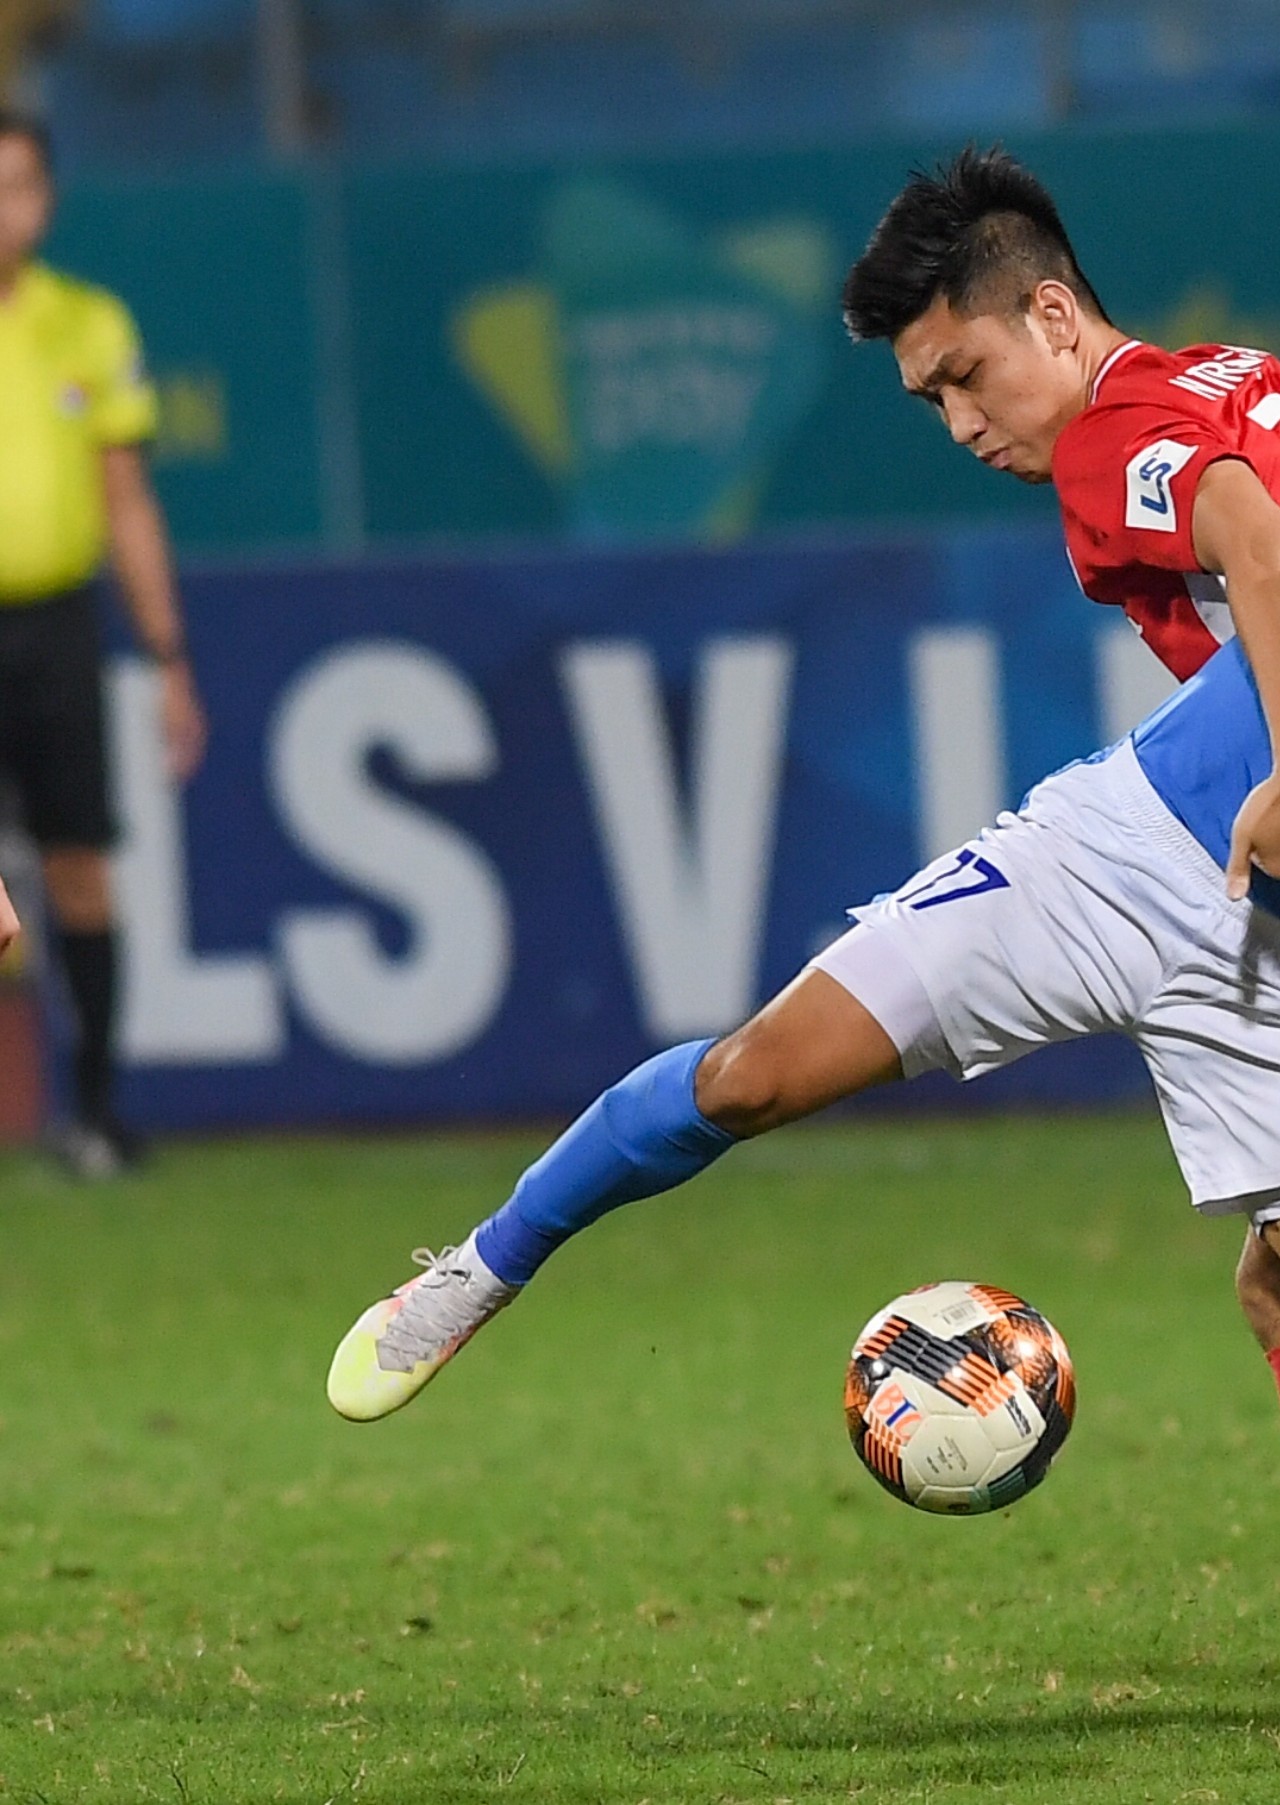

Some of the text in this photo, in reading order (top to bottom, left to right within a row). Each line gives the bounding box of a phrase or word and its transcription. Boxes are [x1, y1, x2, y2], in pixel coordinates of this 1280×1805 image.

[1139, 457, 1172, 515] LS
[106, 637, 512, 1068] LS
[896, 848, 1011, 910] 17
